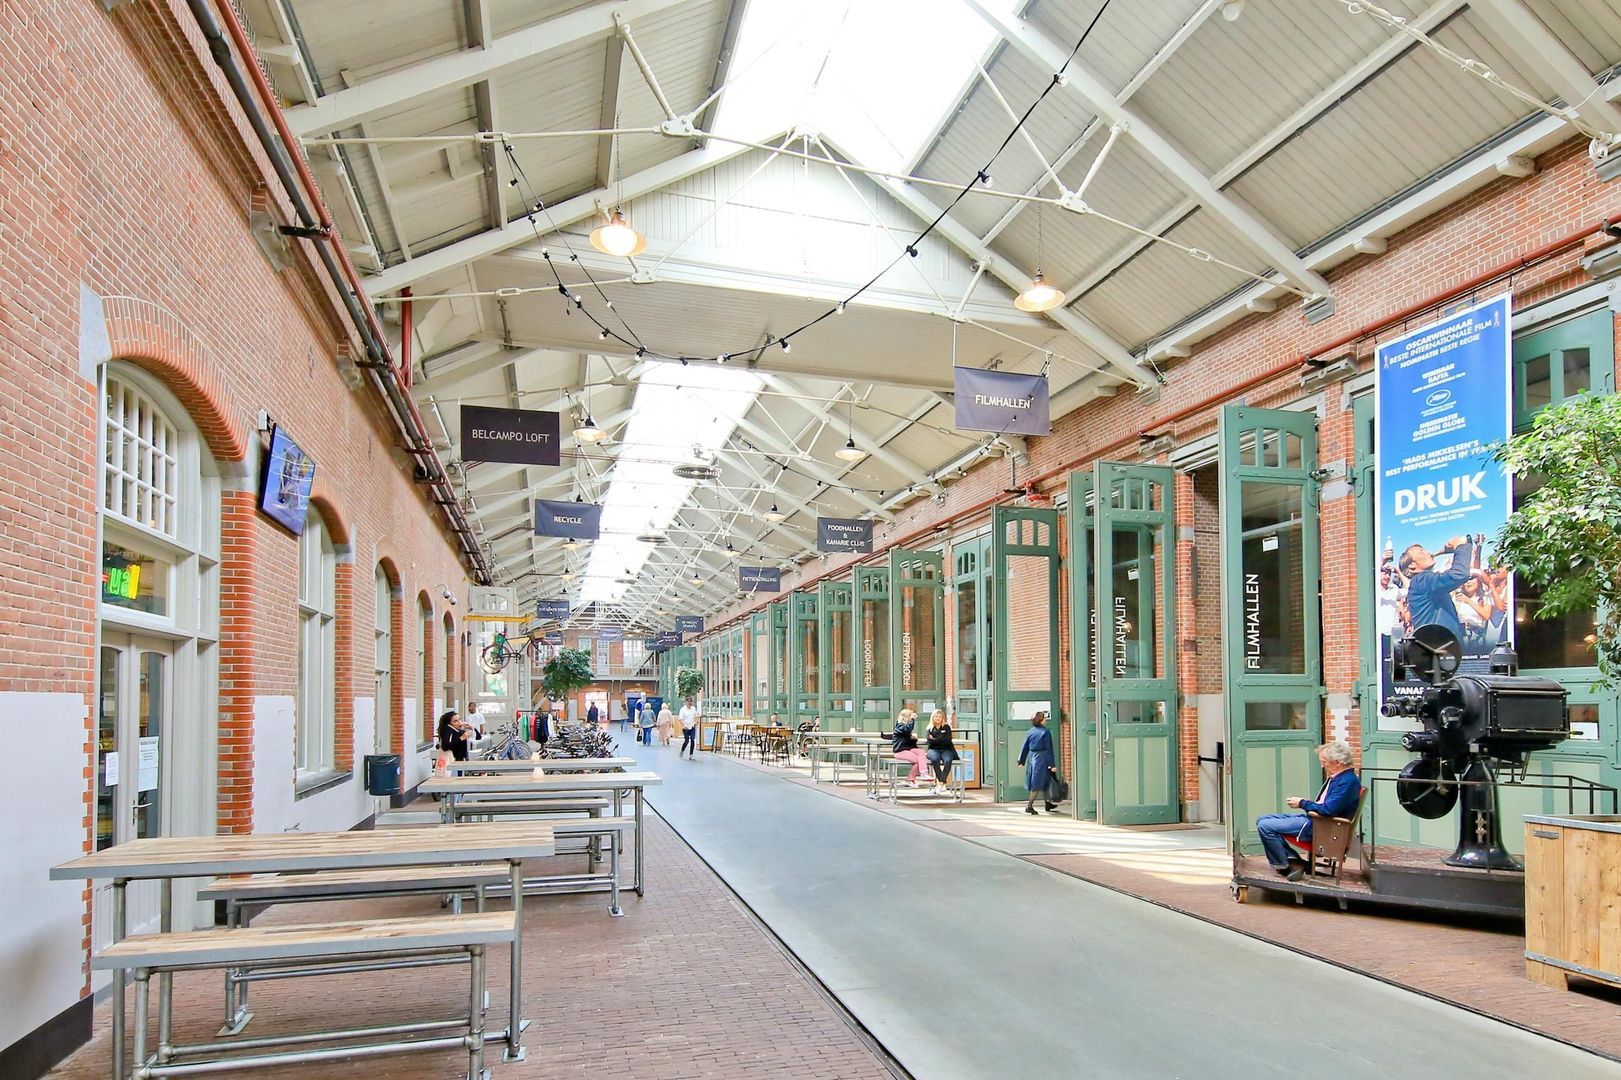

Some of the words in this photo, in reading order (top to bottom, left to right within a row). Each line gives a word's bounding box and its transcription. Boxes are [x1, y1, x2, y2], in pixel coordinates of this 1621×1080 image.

[1389, 354, 1409, 365] BESTE
[1410, 327, 1473, 357] INTERNATIONALE
[1474, 319, 1493, 332] FILM
[1405, 319, 1473, 351] OSCARWINNAAR
[1440, 341, 1459, 354] BESTE
[975, 394, 1031, 409] FILMHALLEN
[472, 428, 523, 442] BELCAMPO
[525, 432, 550, 443] LOFT
[1412, 424, 1442, 437] GOLDEN
[1385, 467, 1401, 477] BEST
[1402, 452, 1457, 473] PERFORMANCE
[1458, 450, 1468, 459] IN
[1394, 470, 1488, 516] DRUK
[553, 515, 582, 525] RECYCLE
[827, 524, 864, 533] FOODHALLEN
[1246, 573, 1261, 669] FILMHALLEN
[903, 632, 911, 686] FOODHALLEN
